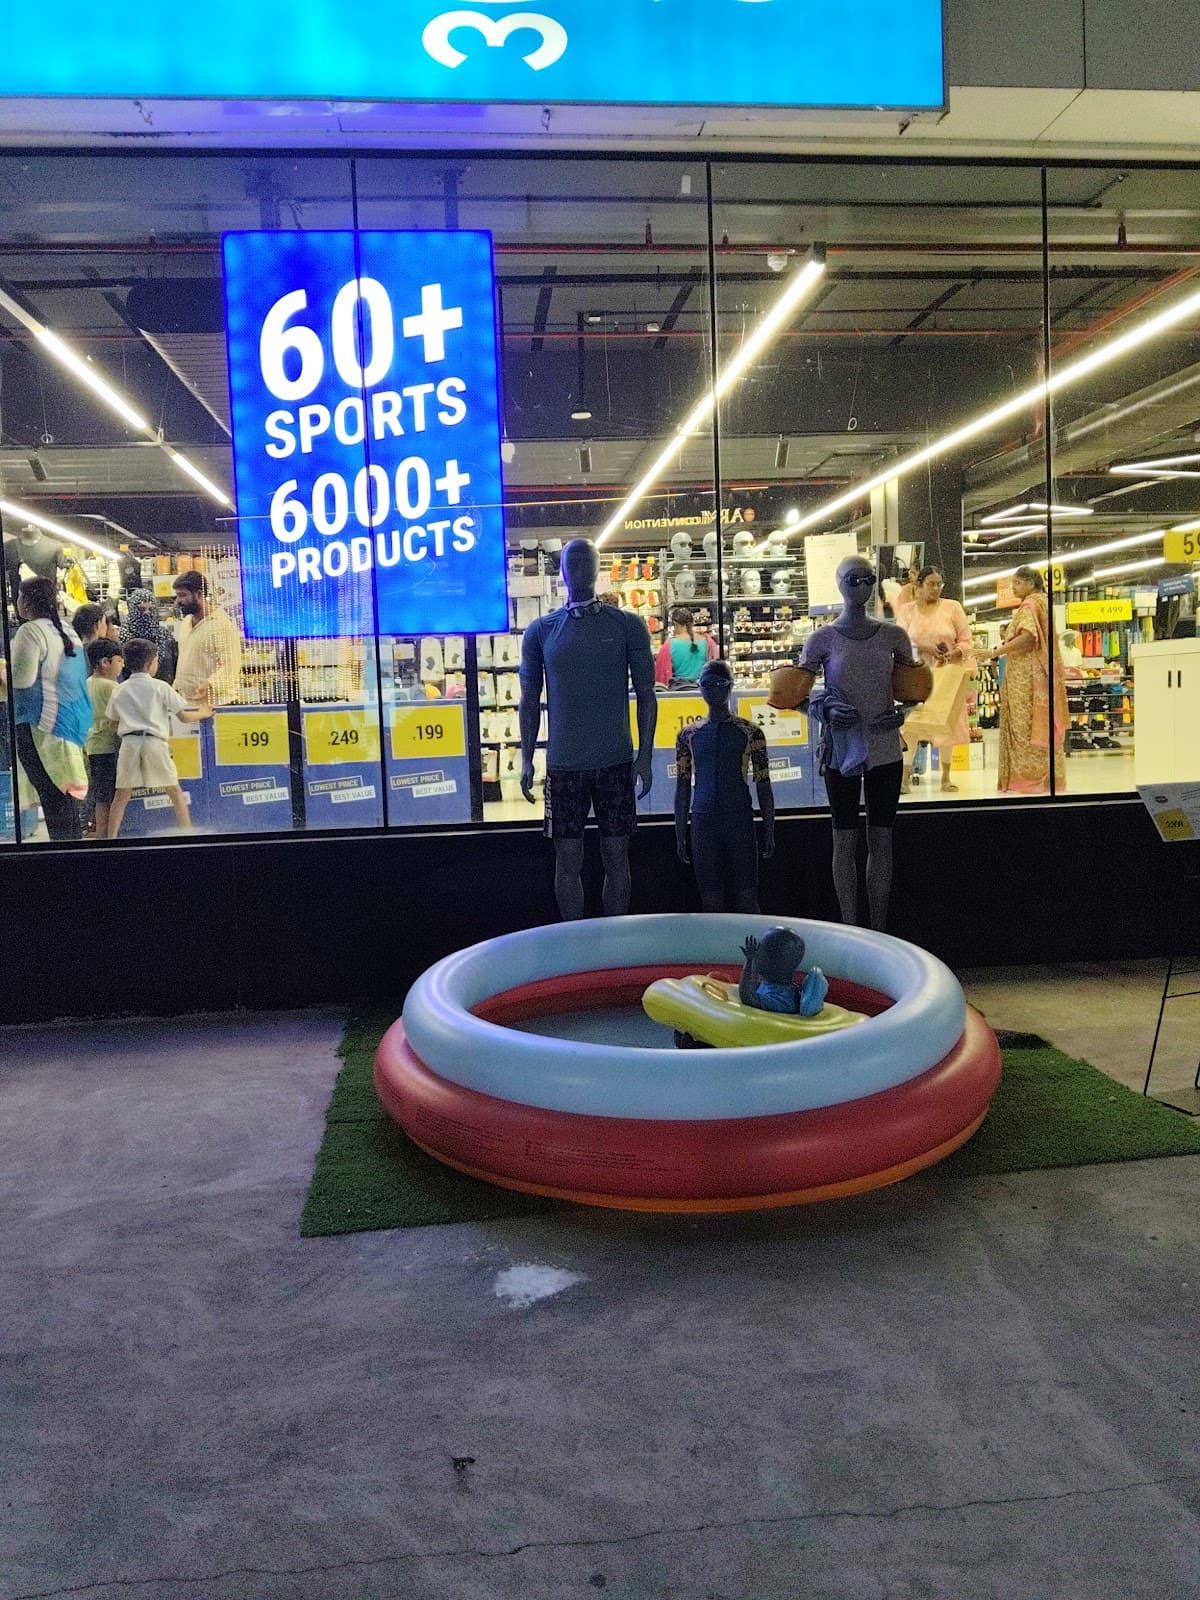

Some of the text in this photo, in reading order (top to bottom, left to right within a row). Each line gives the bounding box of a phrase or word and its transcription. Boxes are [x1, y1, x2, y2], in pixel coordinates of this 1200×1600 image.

[259, 276, 463, 401] 60+
[264, 377, 467, 459] SPORTS
[270, 456, 470, 544] 6000+
[271, 516, 475, 589] PRODUCTS
